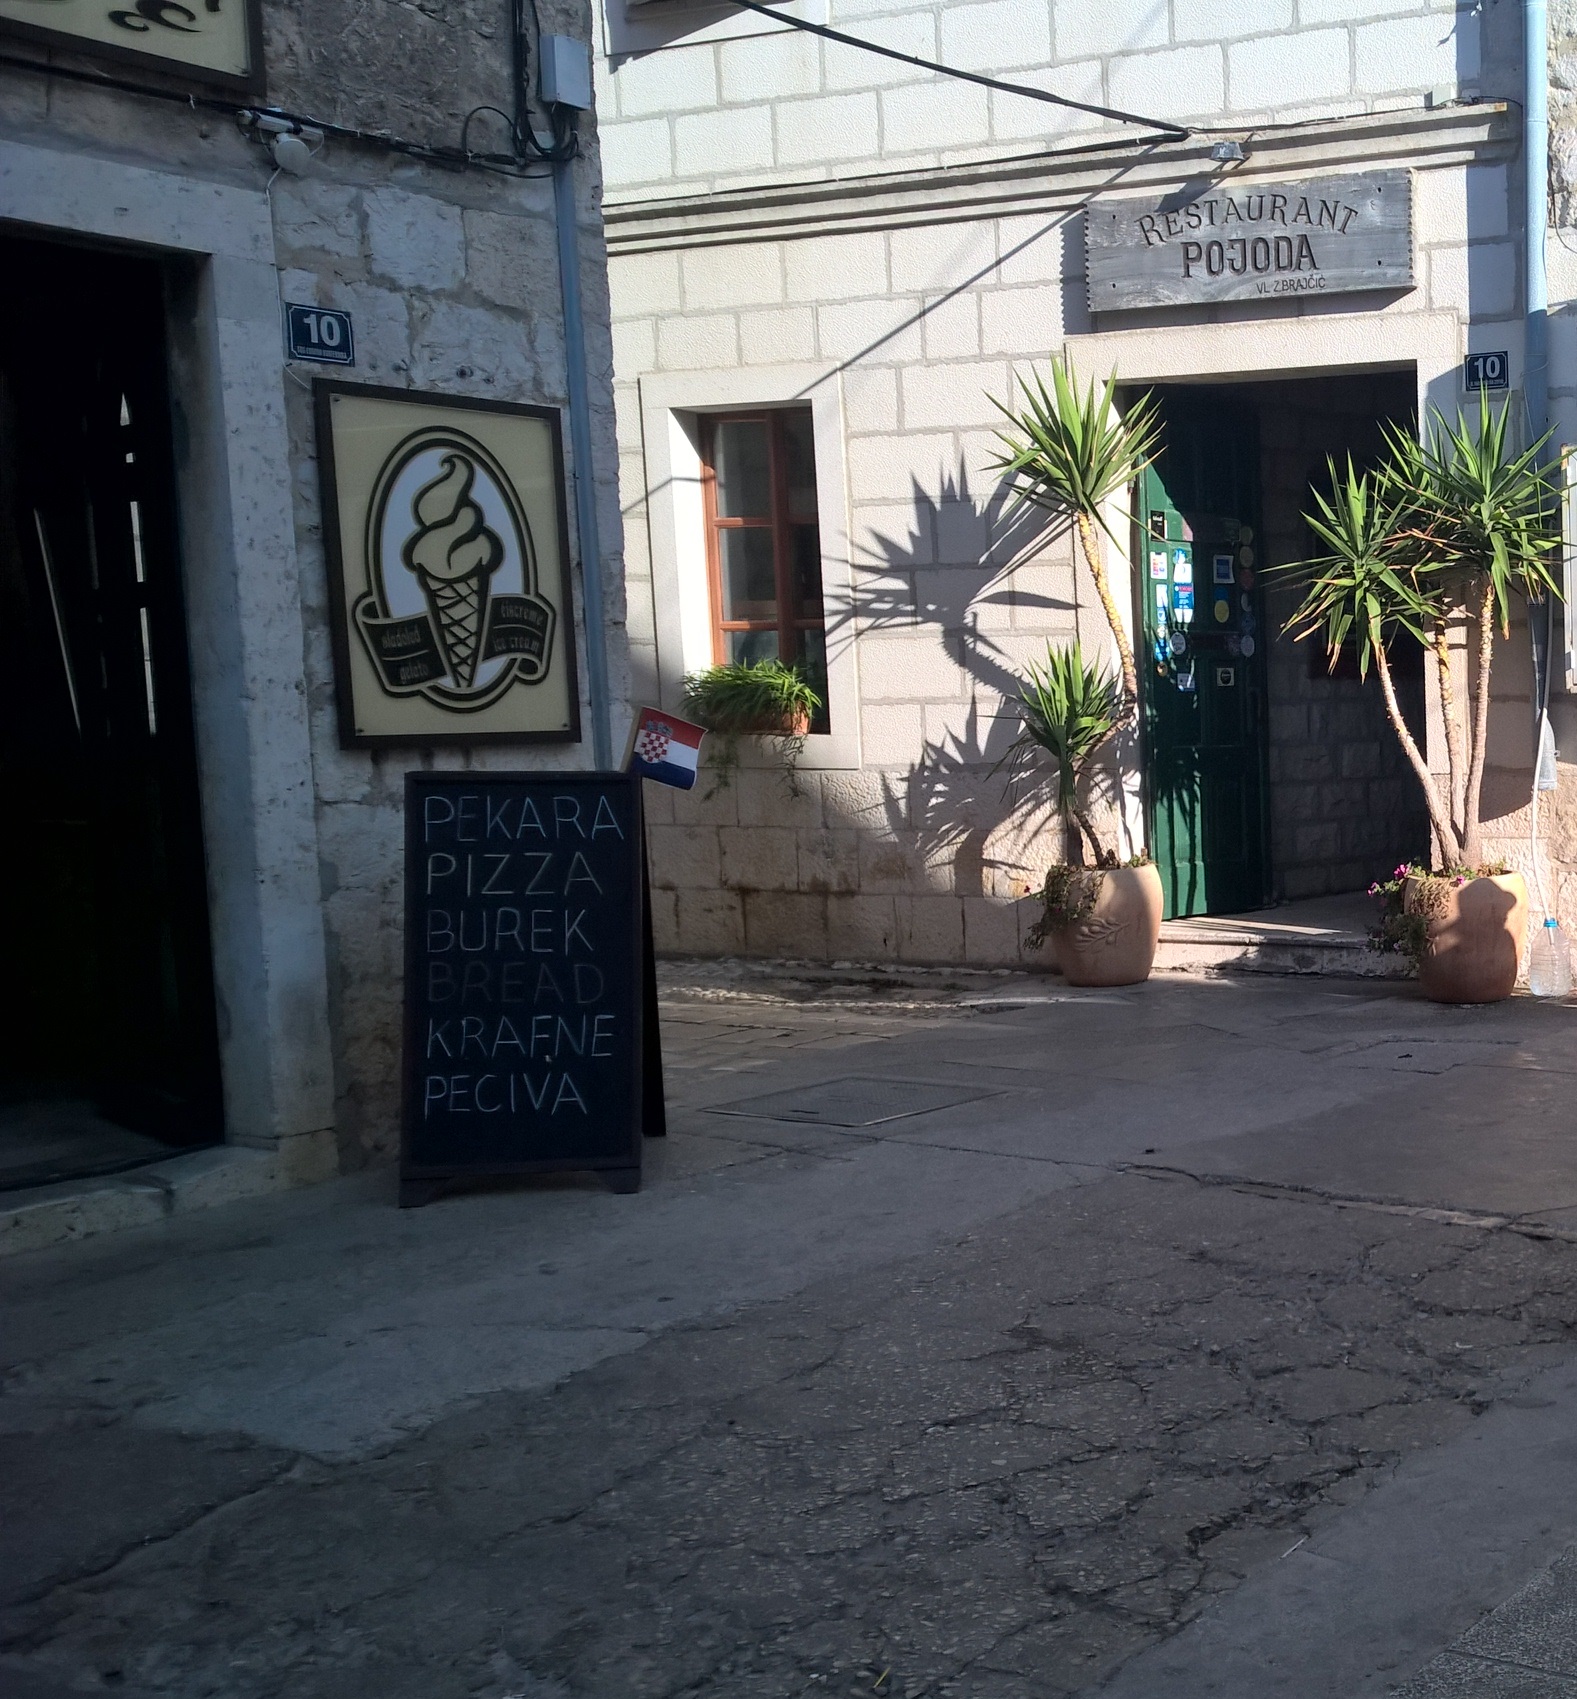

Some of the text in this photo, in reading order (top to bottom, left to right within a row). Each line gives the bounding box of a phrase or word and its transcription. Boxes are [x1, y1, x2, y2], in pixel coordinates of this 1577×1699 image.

[1134, 193, 1359, 247] RESTAURANT
[1181, 233, 1321, 279] POJODA
[303, 313, 341, 347] 10
[1474, 356, 1501, 379] 10
[424, 794, 625, 844] PEKARA
[426, 850, 603, 898] PIZZA
[426, 907, 595, 956] BUREK
[428, 961, 605, 1005] BREAD
[426, 1014, 616, 1060] KRAFNE
[424, 1071, 588, 1120] PECIVA
